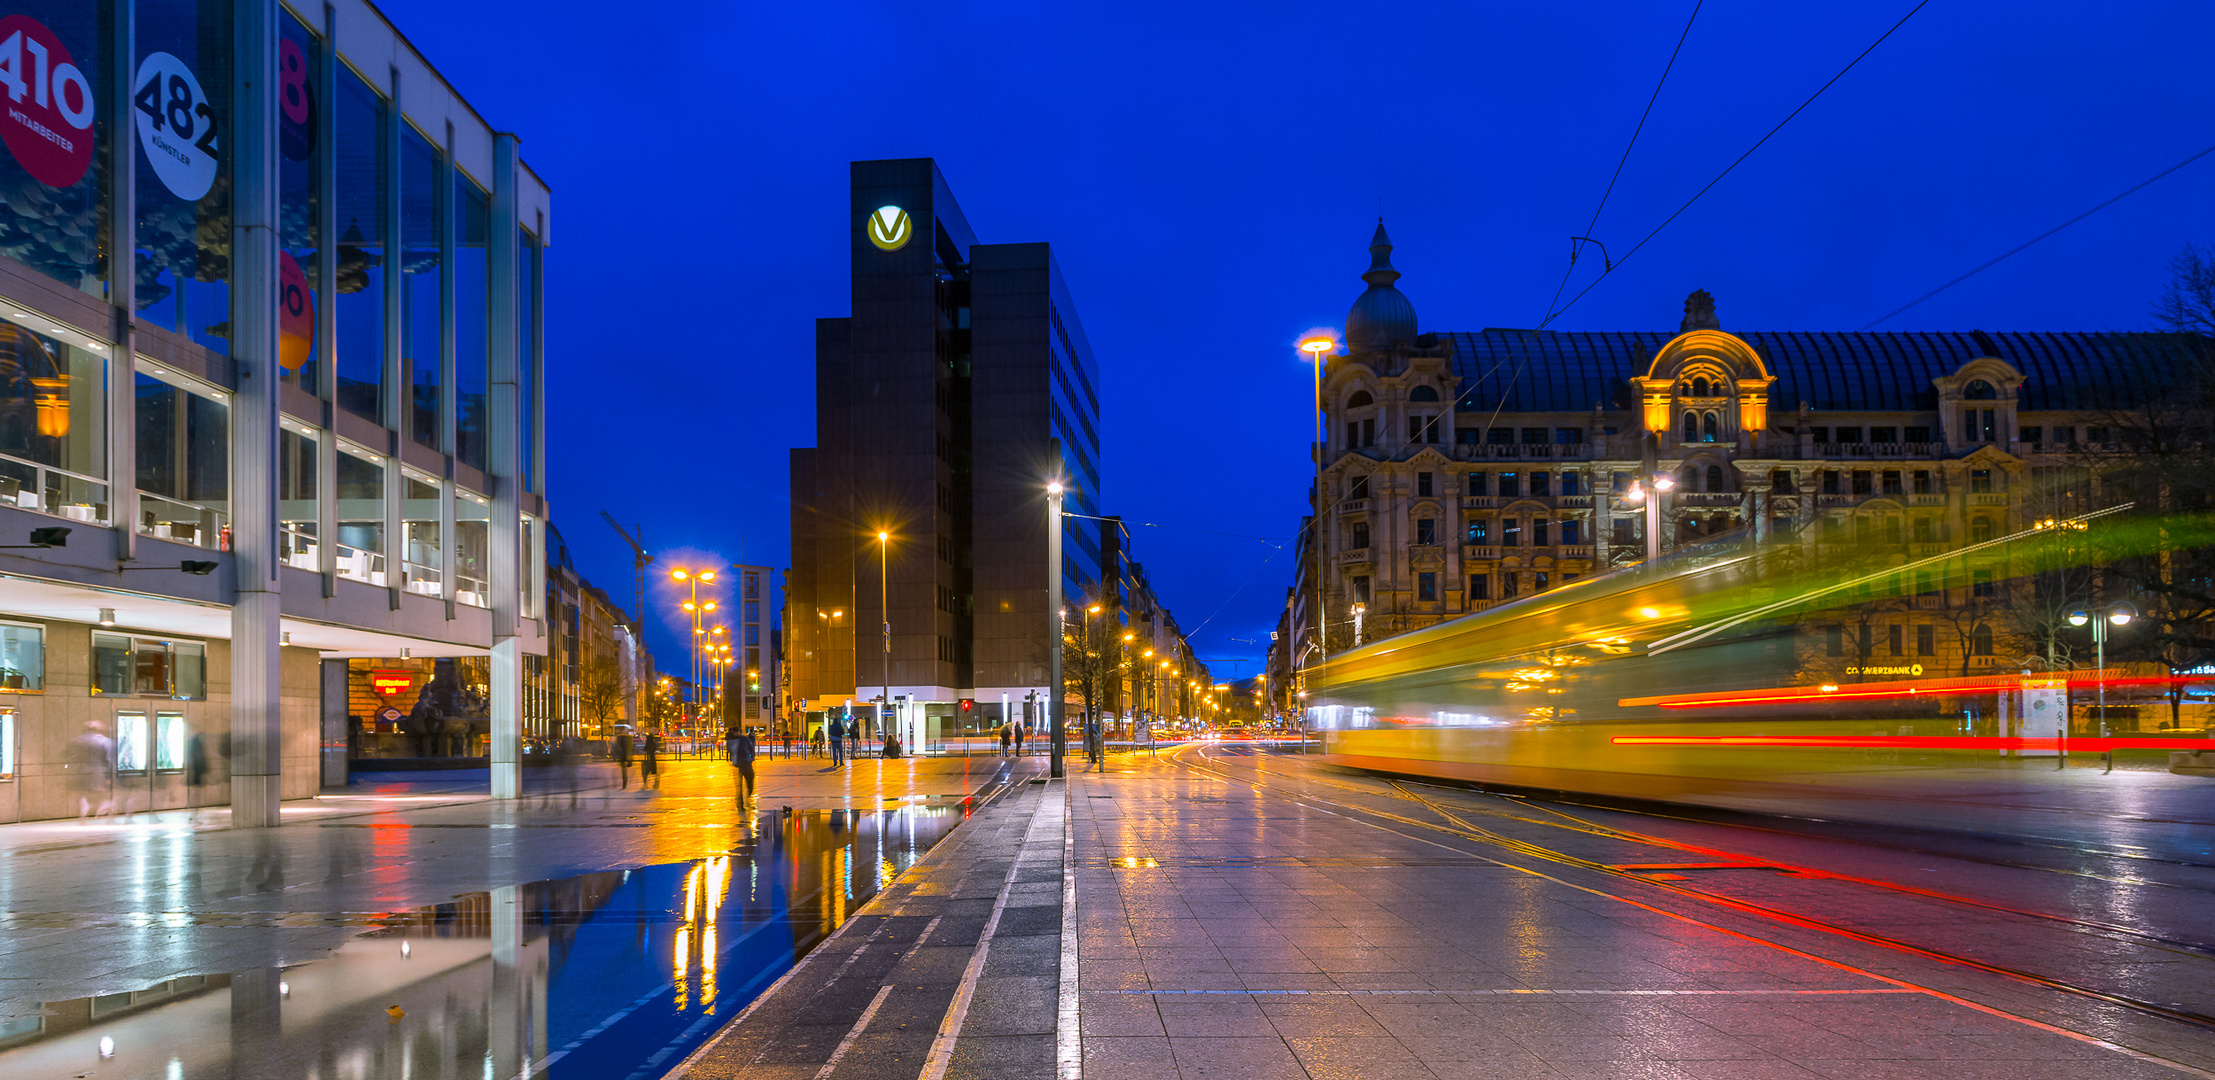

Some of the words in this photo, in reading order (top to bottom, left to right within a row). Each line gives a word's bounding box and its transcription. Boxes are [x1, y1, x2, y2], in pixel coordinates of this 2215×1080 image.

[0, 30, 95, 130] 410
[9, 106, 74, 154] MITARBEITER
[134, 70, 218, 162] 482
[152, 134, 191, 167] KÜNSTLER
